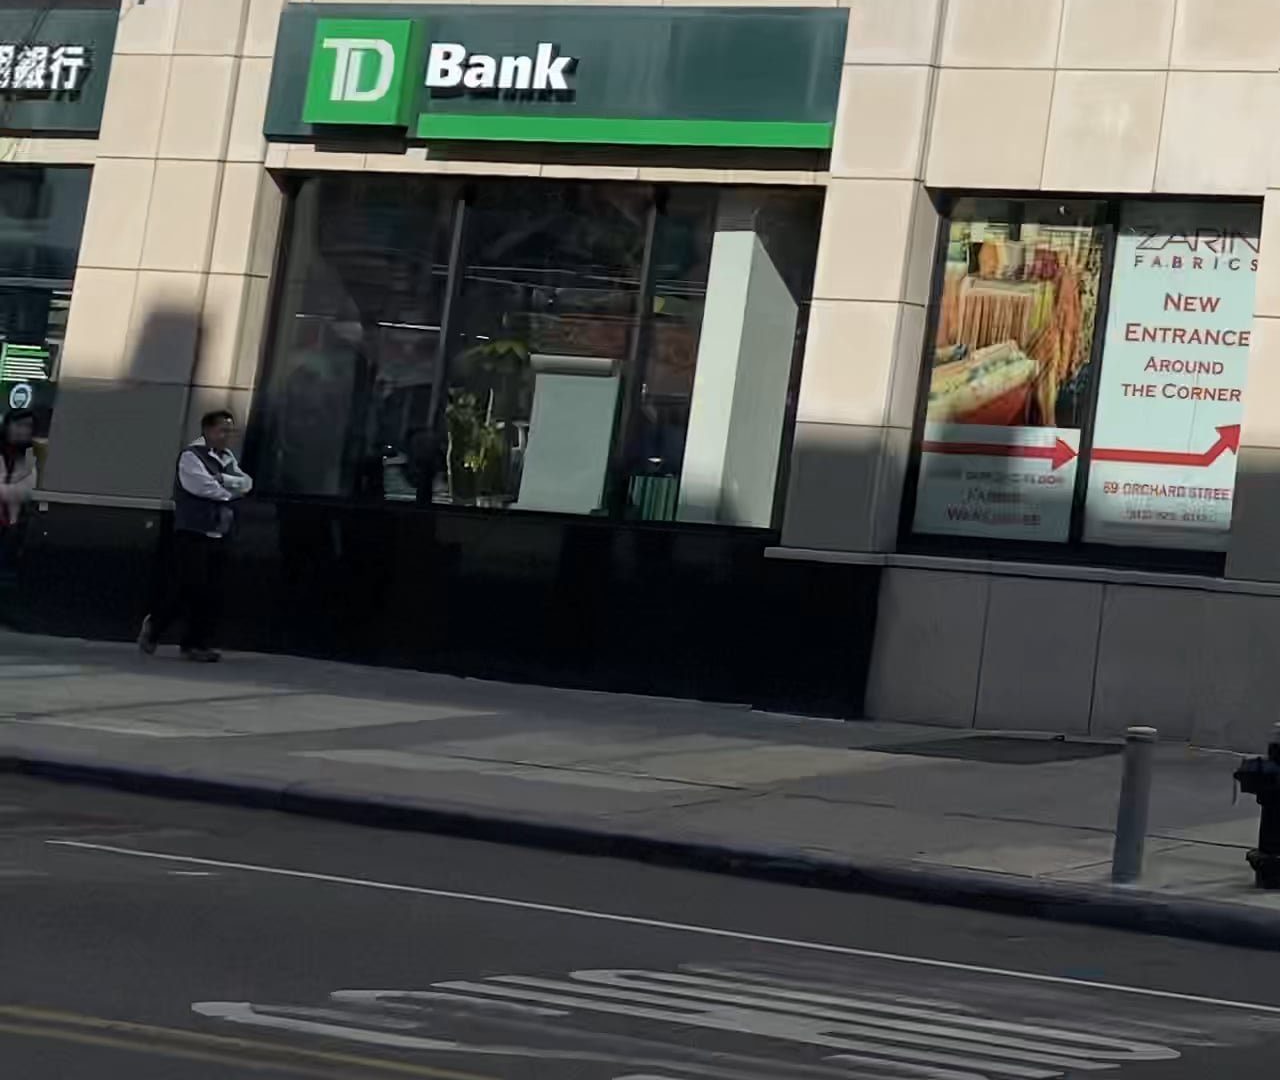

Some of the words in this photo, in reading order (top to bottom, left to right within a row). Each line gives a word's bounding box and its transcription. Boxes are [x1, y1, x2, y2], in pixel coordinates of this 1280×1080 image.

[323, 37, 395, 102] TD
[425, 42, 572, 90] Bank
[1134, 255, 1259, 272] FABRICS
[1163, 292, 1221, 313] NEW
[1125, 322, 1251, 347] ENTRANCE
[1143, 356, 1225, 375] AROUND
[1121, 383, 1157, 398] THE
[1161, 383, 1242, 402] CORNER
